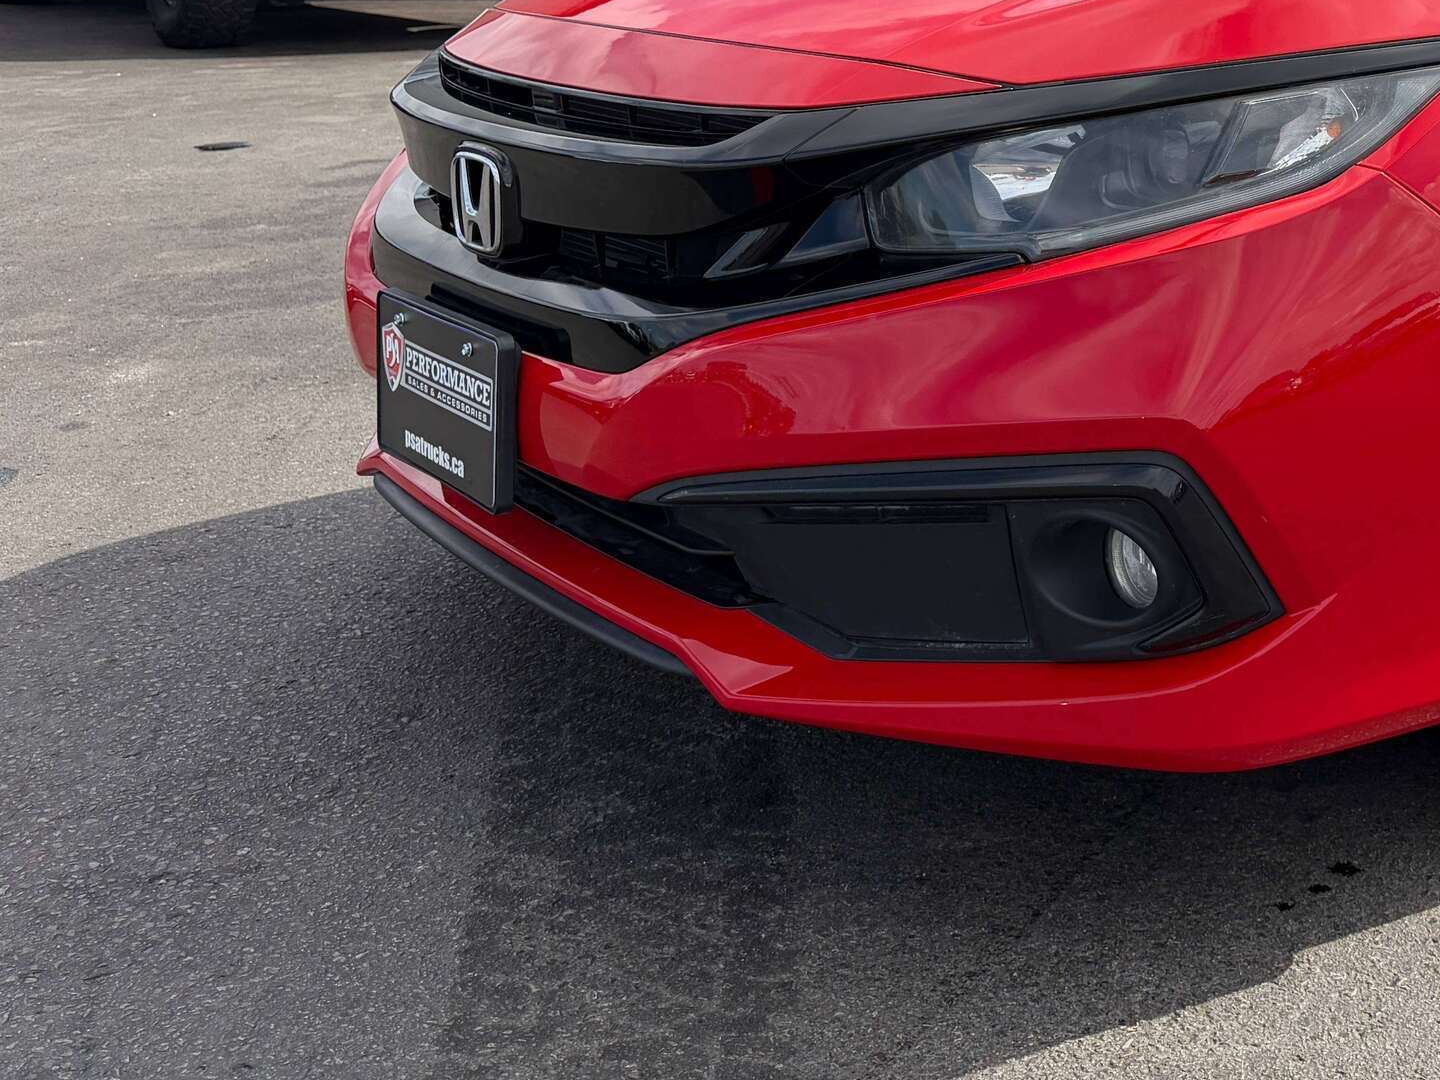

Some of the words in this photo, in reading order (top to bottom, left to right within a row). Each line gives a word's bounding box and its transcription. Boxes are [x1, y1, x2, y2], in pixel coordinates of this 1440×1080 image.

[386, 332, 400, 368] PSA
[405, 346, 491, 407] PERFORMANCE
[407, 375, 429, 394] SALES
[430, 387, 435, 397] &
[437, 391, 488, 423] ACCESSORIES
[404, 429, 465, 479] psatrucks.ca
